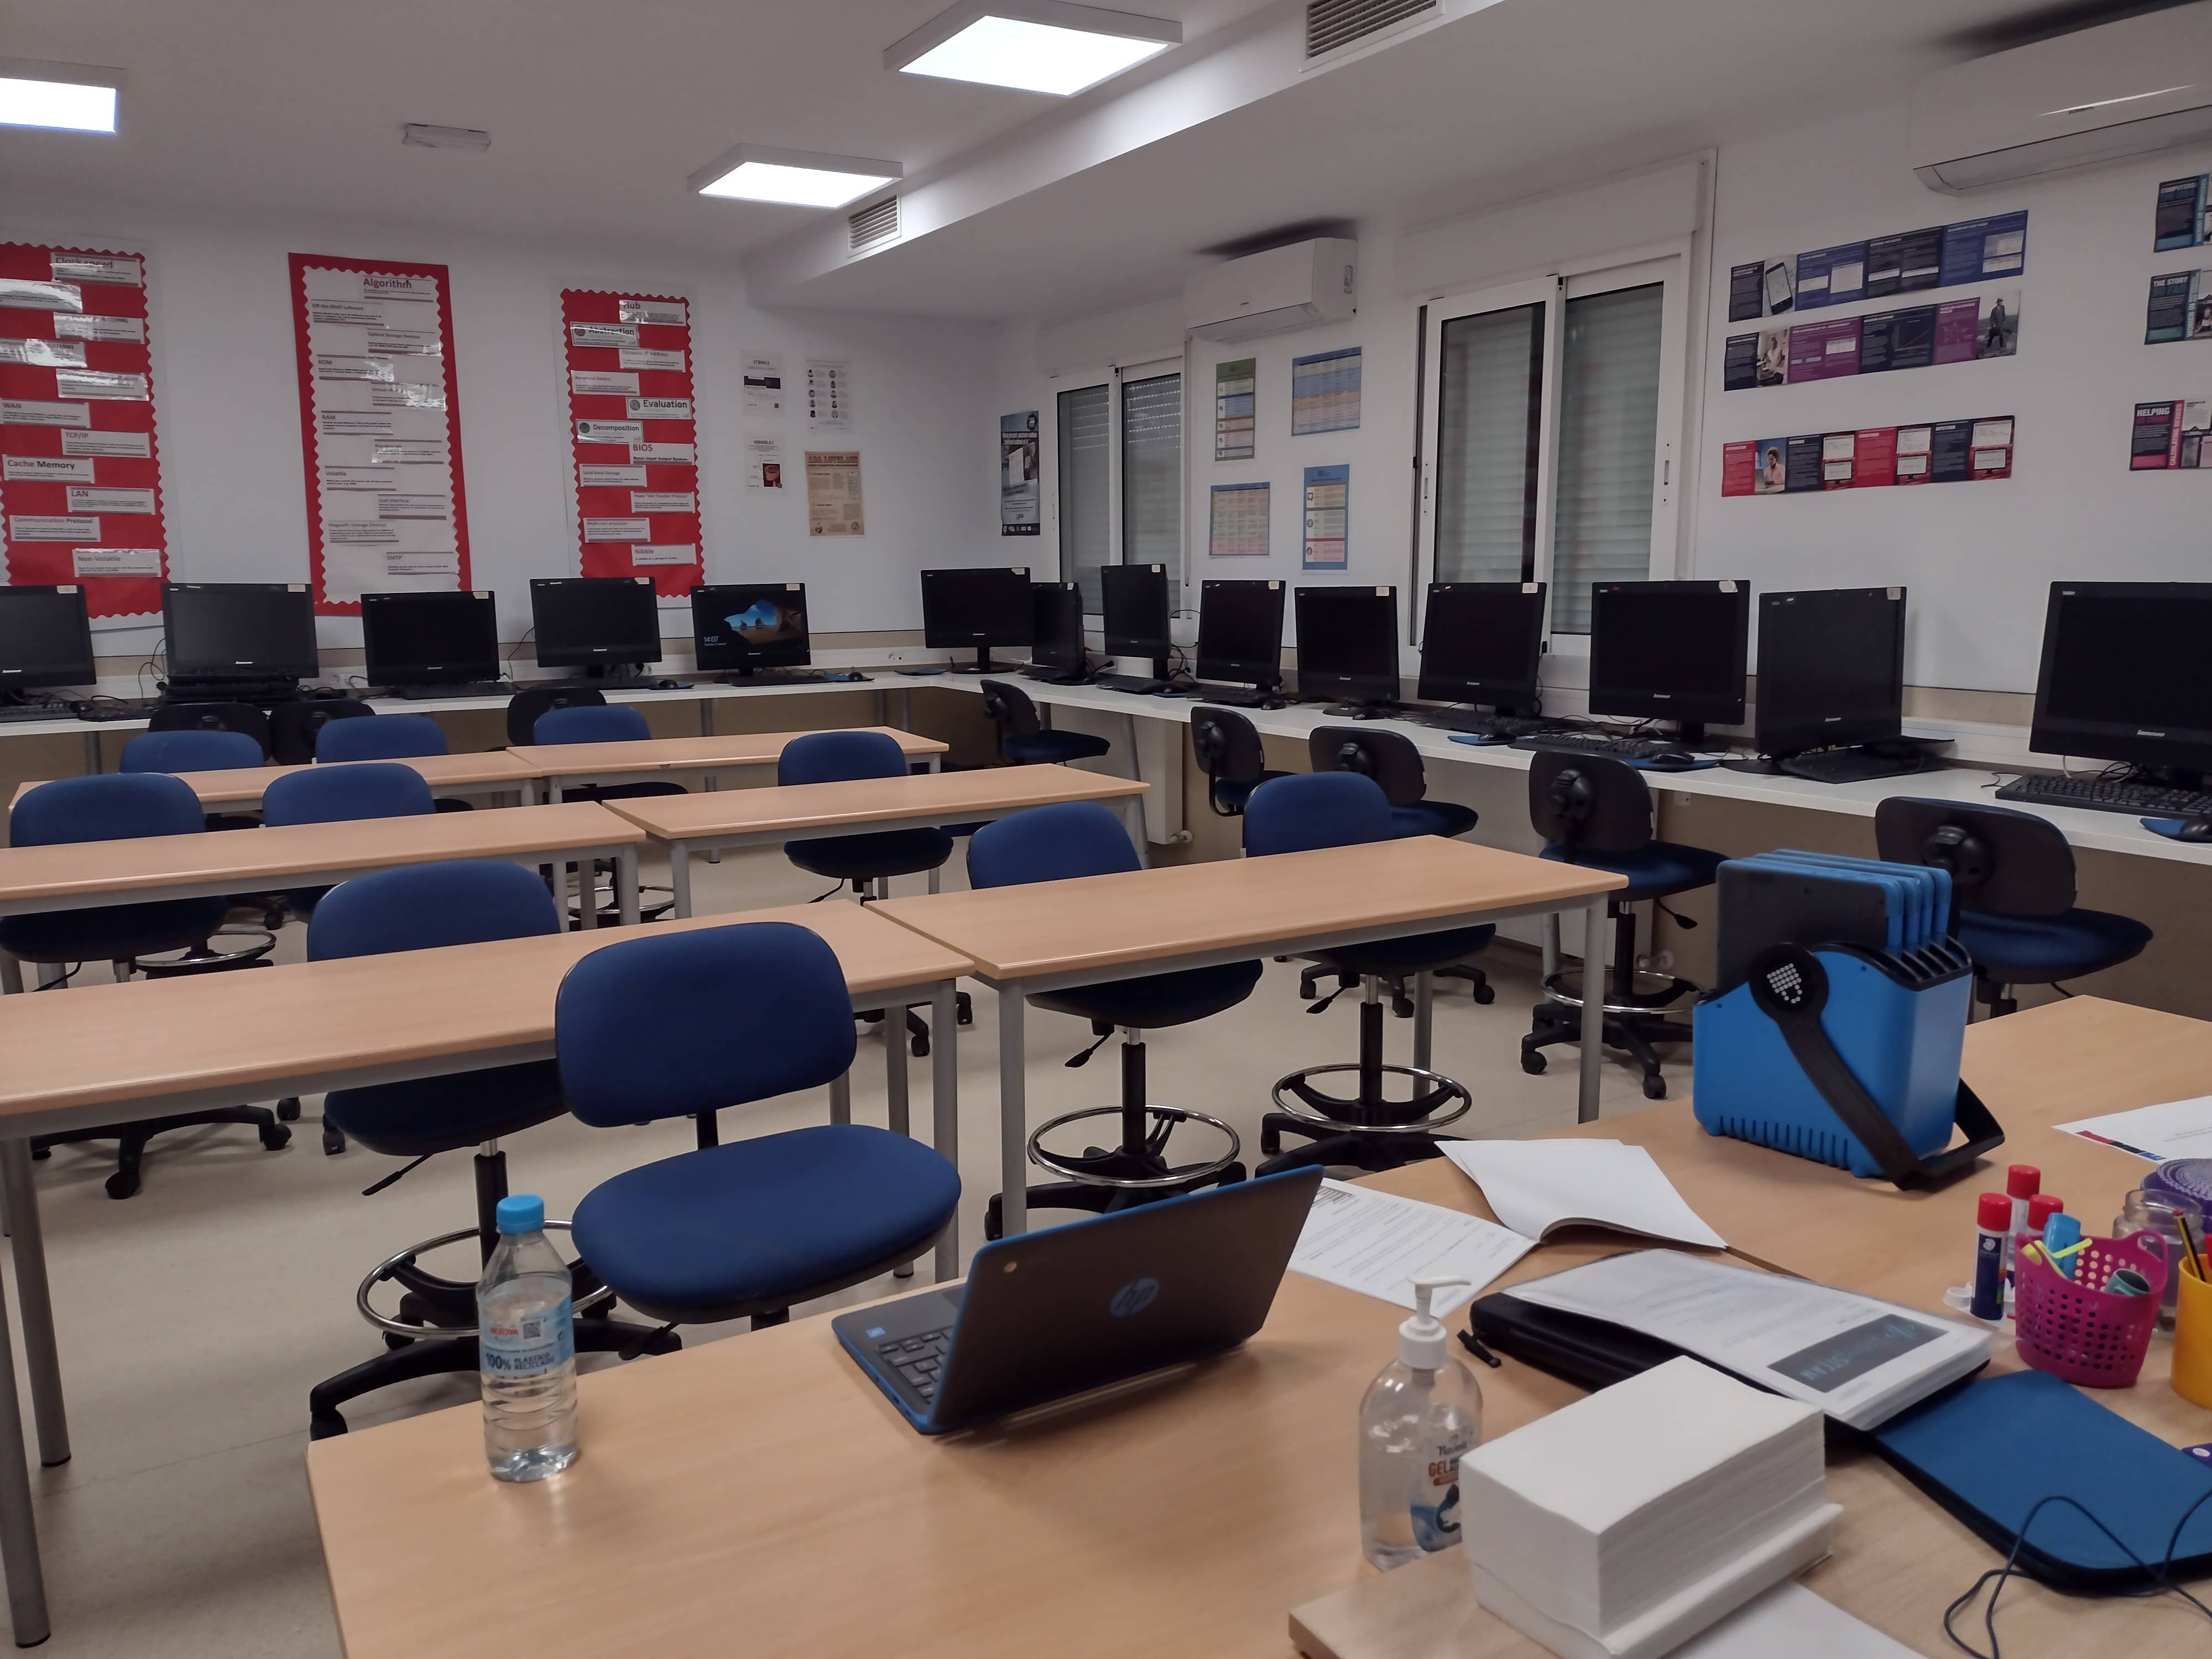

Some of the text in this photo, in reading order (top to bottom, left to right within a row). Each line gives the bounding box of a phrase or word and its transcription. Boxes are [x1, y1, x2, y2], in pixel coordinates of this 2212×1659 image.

[363, 278, 412, 289] Algorithm
[2167, 276, 2188, 285] STORY
[643, 400, 687, 408] Evaluation
[2137, 407, 2171, 417] HELPING
[593, 424, 639, 432] Decomposition
[7, 460, 75, 471] Cache Memory
[485, 1352, 512, 1370] 100%
[1428, 1460, 1448, 1477] GEL
